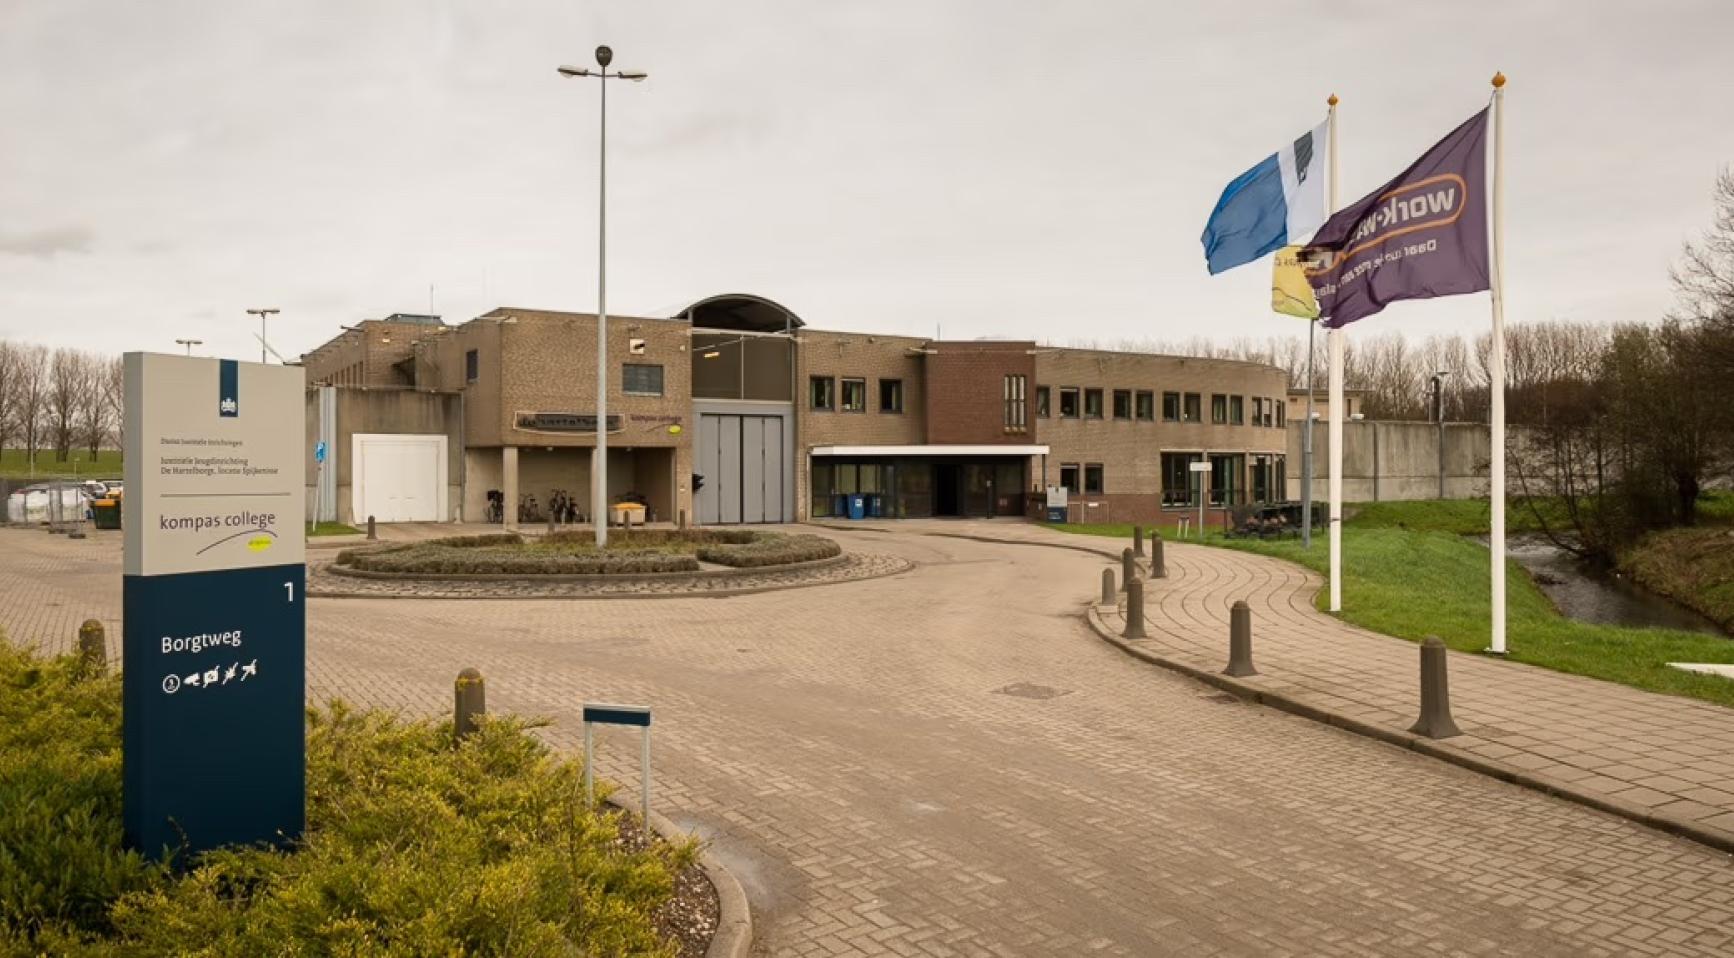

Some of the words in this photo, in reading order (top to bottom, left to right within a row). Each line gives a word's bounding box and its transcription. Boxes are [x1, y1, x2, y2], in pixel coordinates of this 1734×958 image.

[160, 514, 221, 533] kompas
[224, 511, 276, 528] college
[284, 581, 294, 602] 1
[162, 630, 242, 653] Borgtweg
